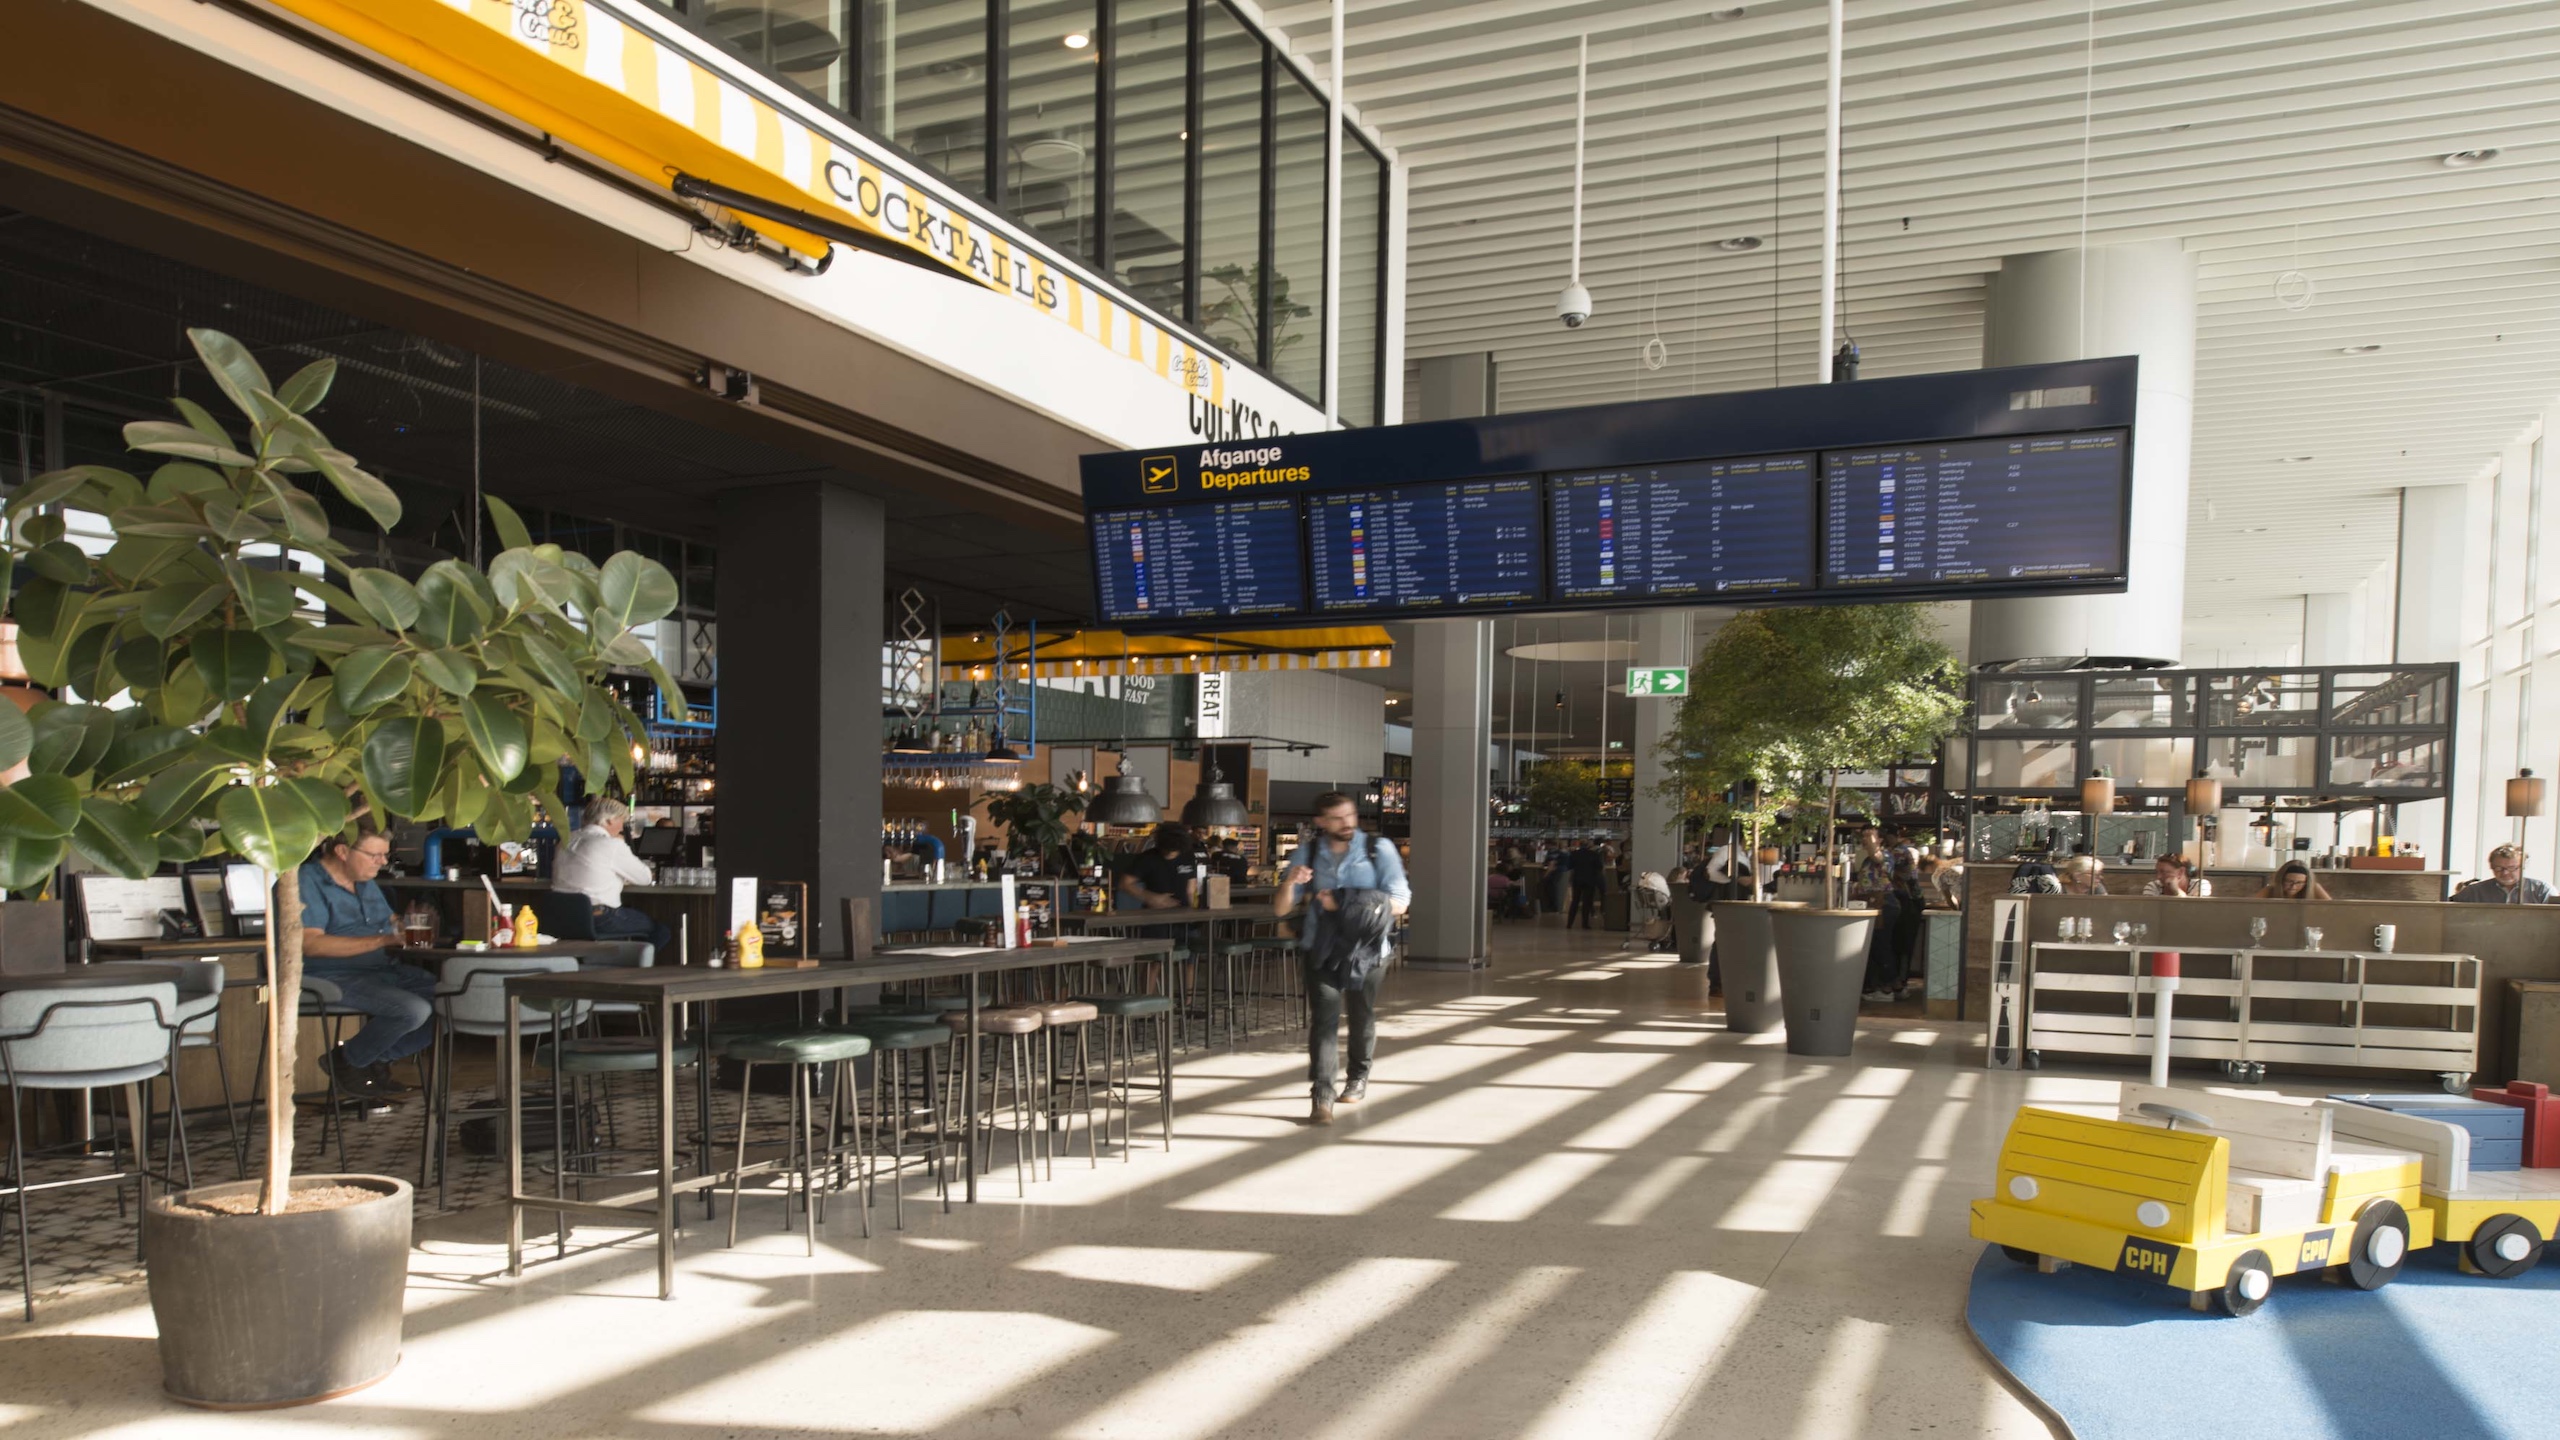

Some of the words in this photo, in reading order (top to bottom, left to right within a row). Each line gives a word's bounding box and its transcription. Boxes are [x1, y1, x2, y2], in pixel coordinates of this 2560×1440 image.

[824, 160, 1058, 310] COCKTAILS
[1199, 446, 1282, 469] Afgange
[1200, 467, 1311, 491] Departures
[1124, 674, 1155, 690] FOOD
[1124, 688, 1150, 705] FAST
[2125, 1246, 2167, 1276] CPH
[2302, 1238, 2329, 1263] CPH
